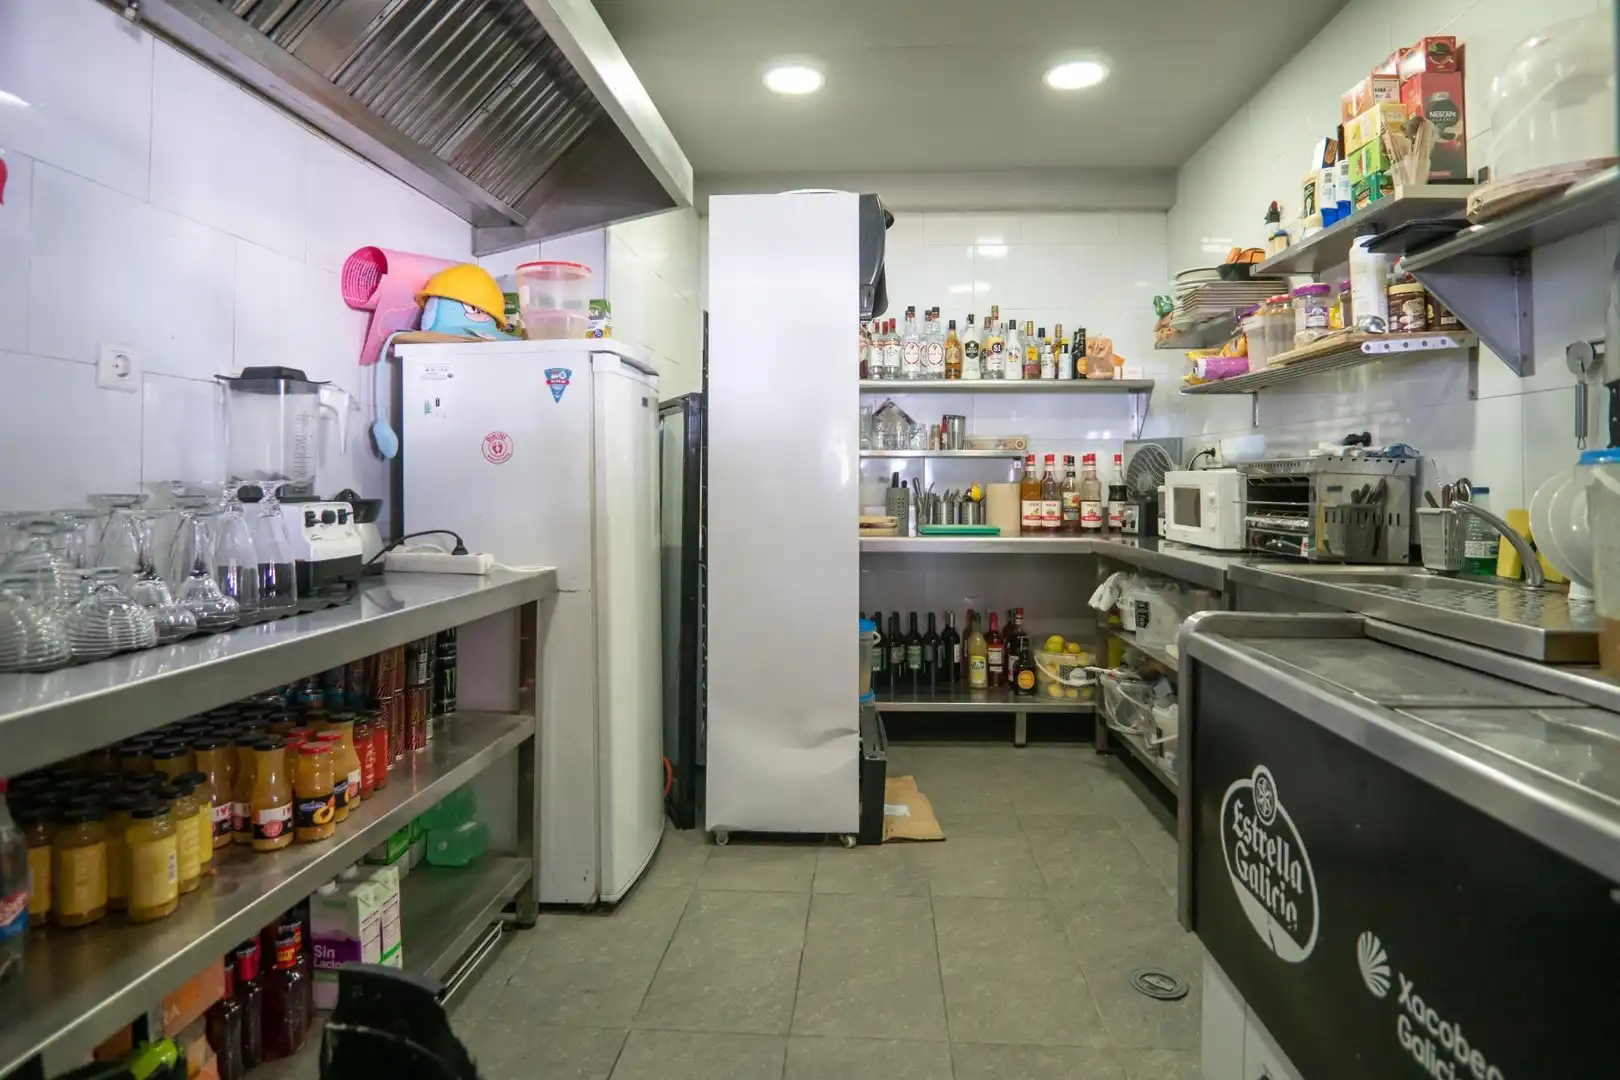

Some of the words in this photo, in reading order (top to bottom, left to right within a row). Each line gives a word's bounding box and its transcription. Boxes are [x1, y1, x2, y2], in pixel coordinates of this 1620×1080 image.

[993, 344, 1001, 352] 51
[1232, 798, 1304, 894] Estrella
[1235, 840, 1298, 931] Galicia
[313, 944, 336, 959] Sin
[1397, 1014, 1459, 1080] Galici
